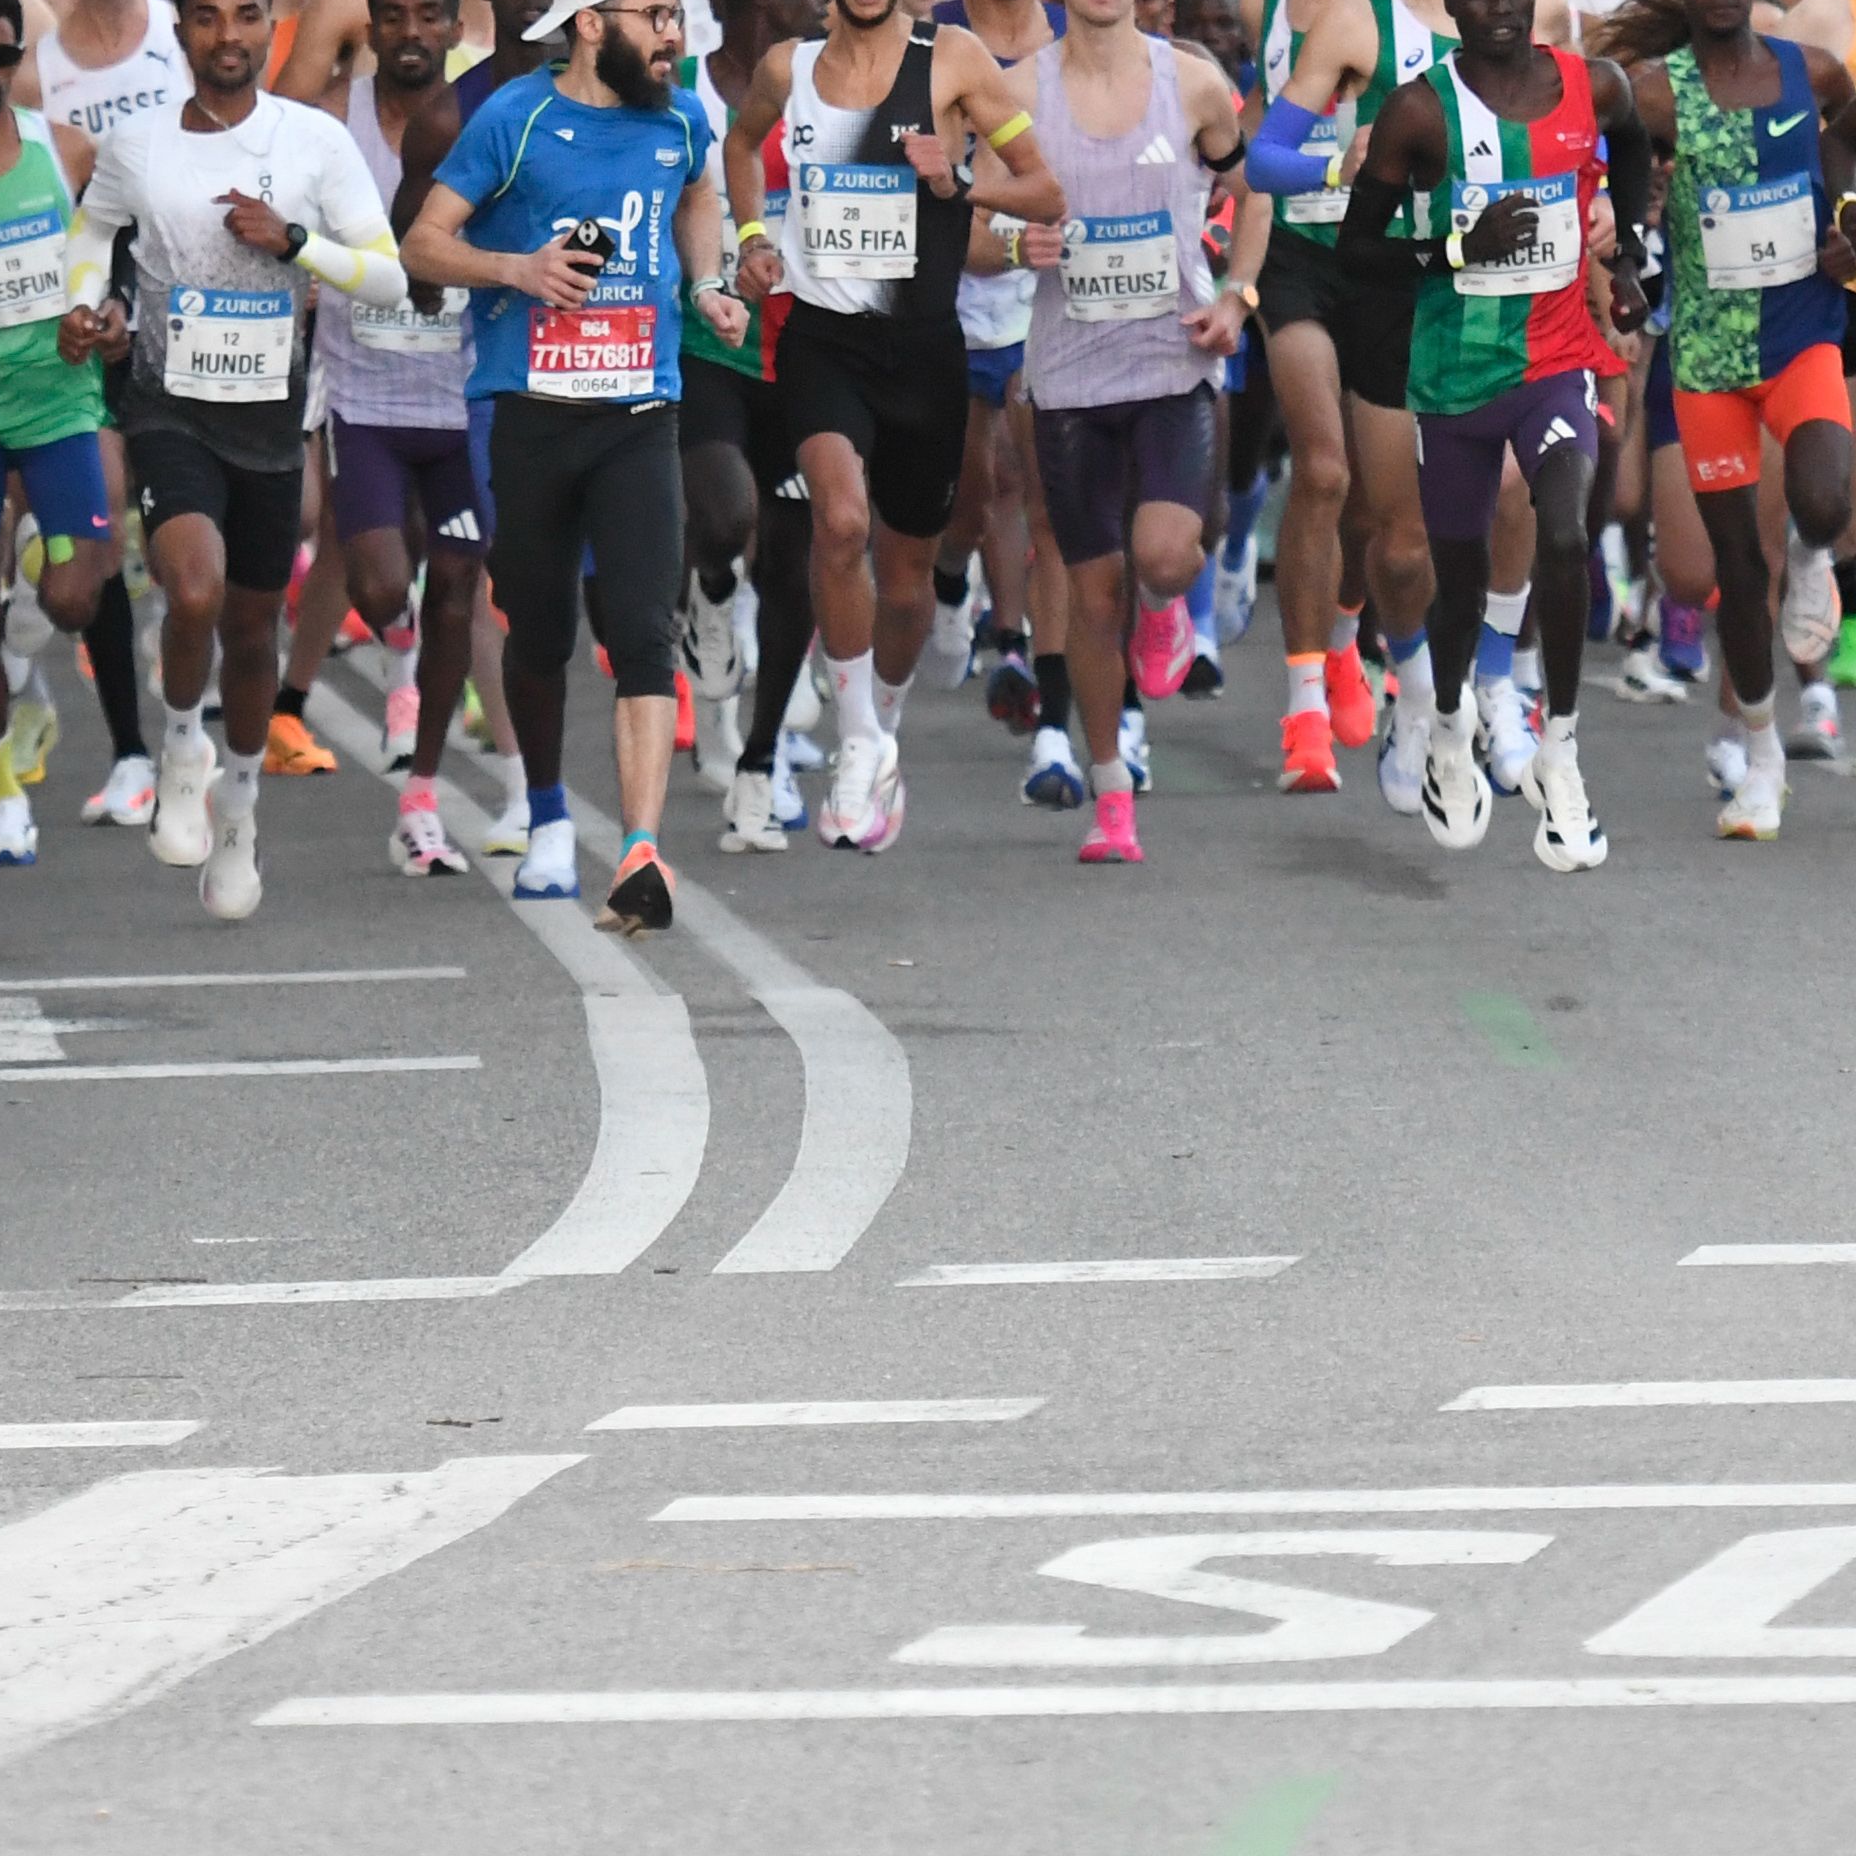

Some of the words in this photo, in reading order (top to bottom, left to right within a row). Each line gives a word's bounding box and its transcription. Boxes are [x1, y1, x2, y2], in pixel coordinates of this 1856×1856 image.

[833, 173, 899, 189] ZURICH
[1738, 182, 1799, 207] ZURICH
[843, 208, 861, 221] 28
[648, 189, 665, 276] FRANCE
[1094, 217, 1159, 239] ZURICH
[860, 230, 907, 251] FIFA
[1750, 240, 1776, 262] 54
[1107, 254, 1125, 269] 22
[1068, 270, 1168, 296] MATEUSZ
[587, 285, 644, 303] URICH
[212, 297, 281, 315] ZURICH
[579, 320, 611, 337] 664
[223, 331, 240, 346] 12
[191, 351, 266, 375] HUNDE
[531, 342, 652, 369] 771576817
[571, 377, 619, 393] 00664
